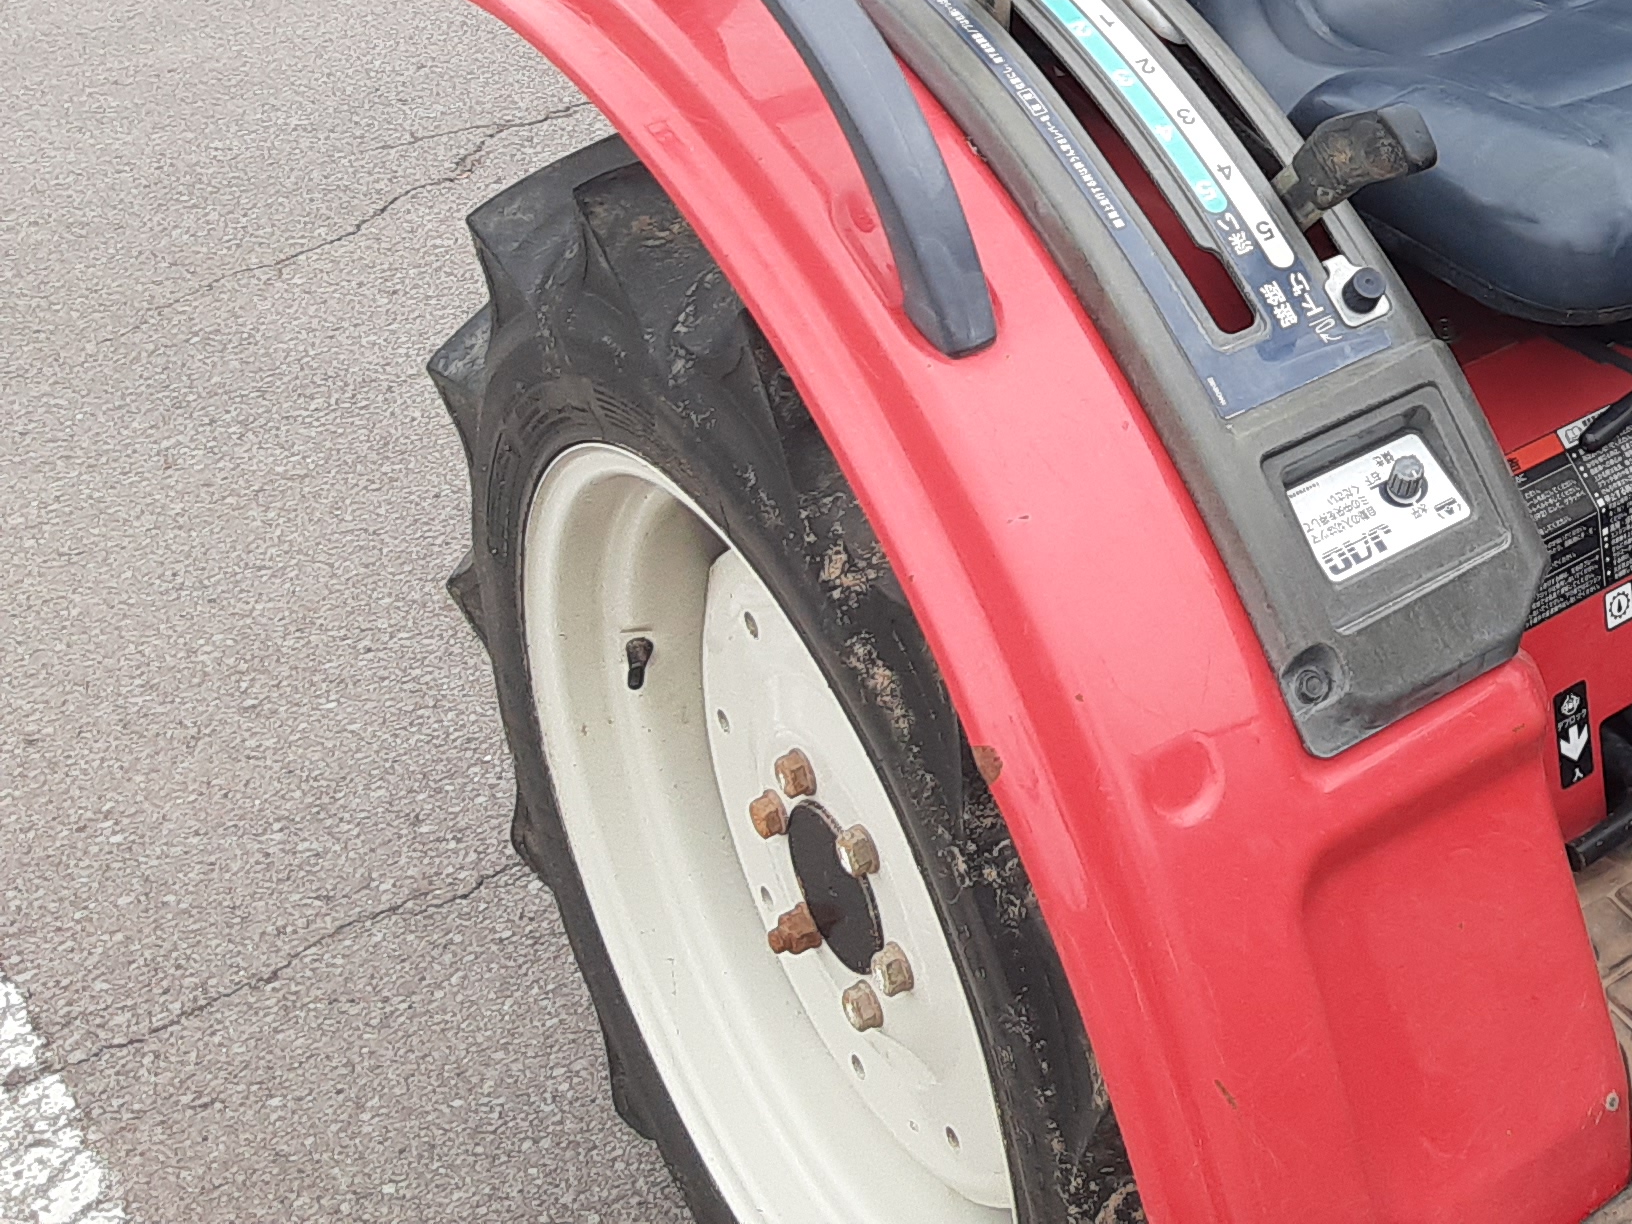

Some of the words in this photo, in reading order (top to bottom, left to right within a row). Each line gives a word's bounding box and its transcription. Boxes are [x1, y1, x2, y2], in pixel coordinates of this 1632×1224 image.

[1099, 14, 1115, 28] 1
[1135, 58, 1156, 74] 2
[1176, 108, 1196, 125] 3
[1216, 163, 1232, 181] 4
[1217, 212, 1254, 256] 深い
[1255, 220, 1275, 242] 5
[1259, 281, 1298, 328] 解除
[1290, 272, 1324, 317] 下げ
[1327, 484, 1360, 505] ください
